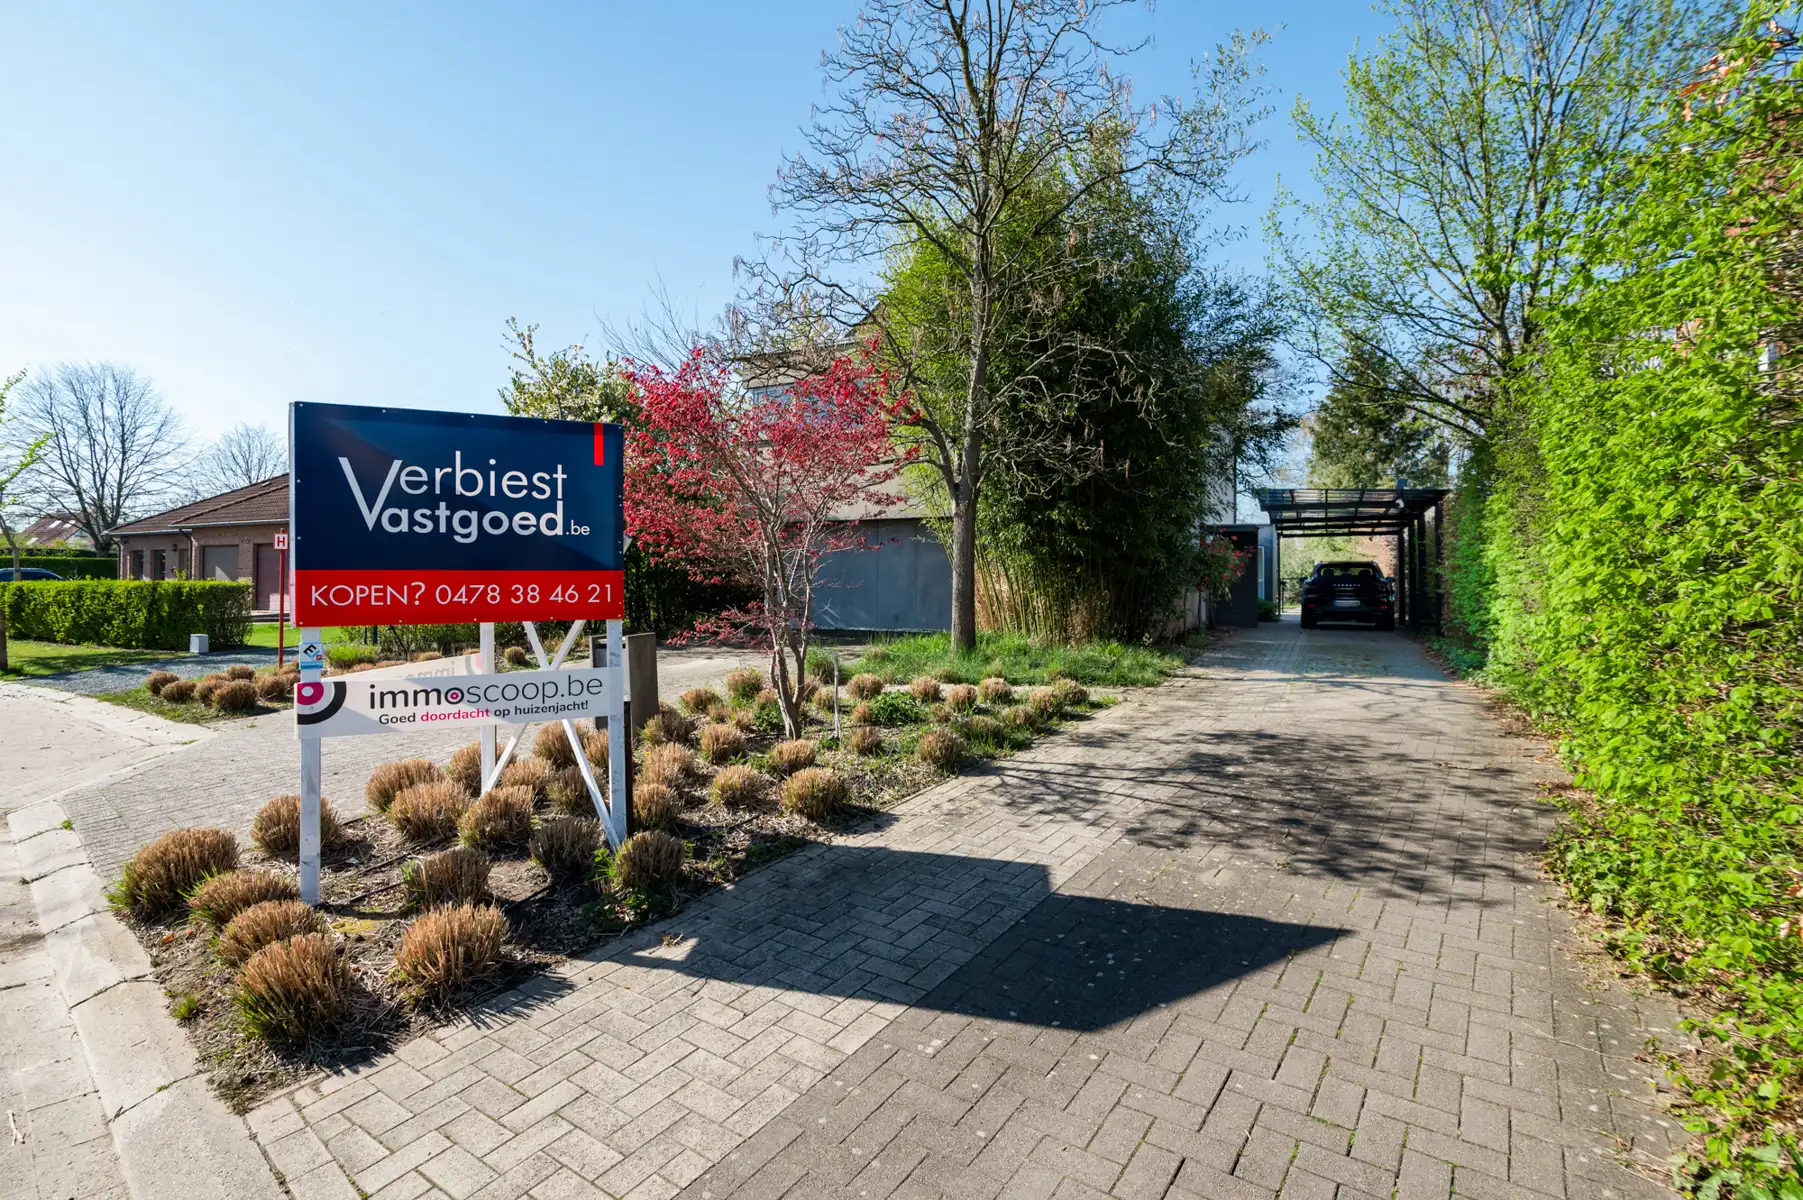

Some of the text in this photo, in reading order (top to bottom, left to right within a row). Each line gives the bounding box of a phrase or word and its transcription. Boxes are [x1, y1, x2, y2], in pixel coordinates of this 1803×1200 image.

[338, 450, 568, 531] Verbiest
[277, 535, 286, 547] H
[311, 582, 612, 607] KOPEN? 0478 38 46 21
[369, 674, 603, 709] immoscoop.be
[379, 700, 589, 725] Goed doordacht op huizenjacht!
